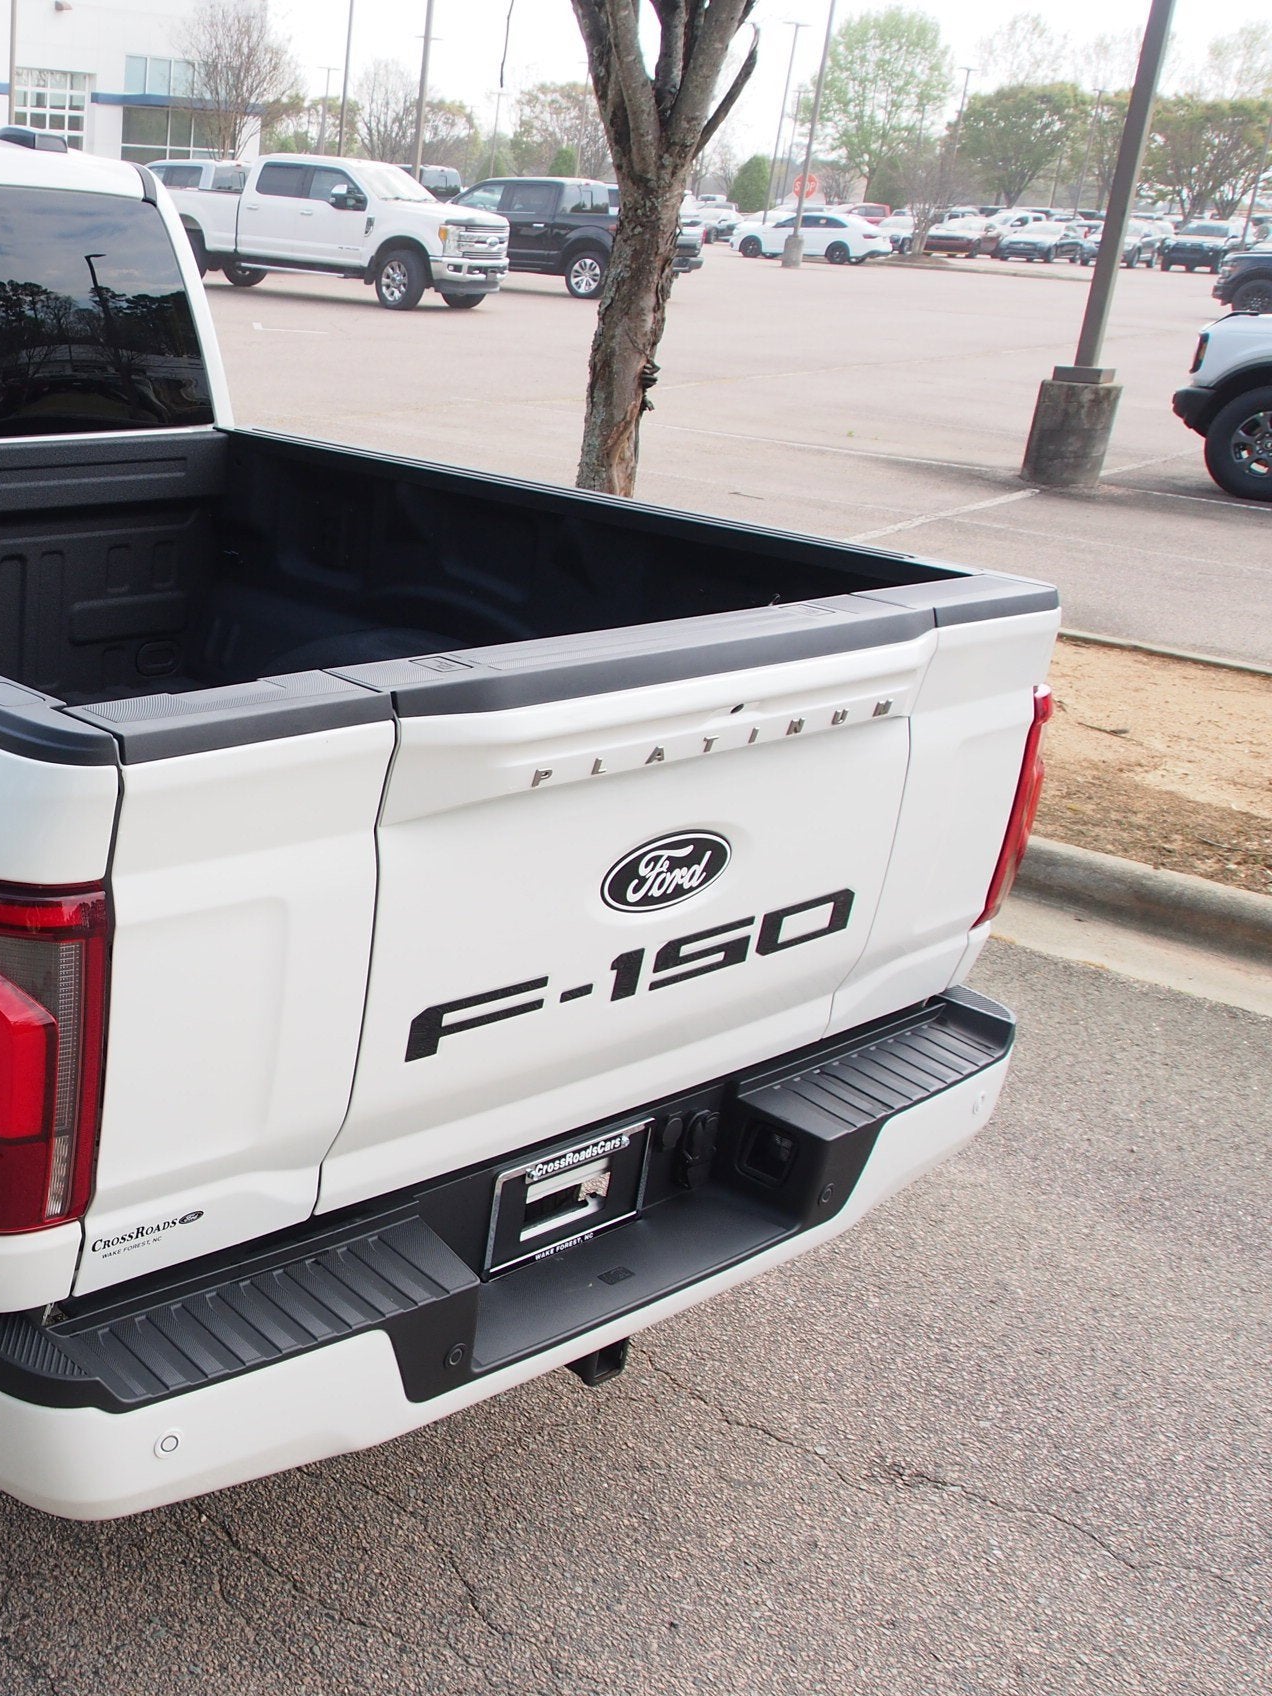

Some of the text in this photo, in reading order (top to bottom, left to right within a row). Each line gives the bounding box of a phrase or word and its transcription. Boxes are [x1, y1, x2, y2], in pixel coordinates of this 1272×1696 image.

[530, 697, 895, 788] PLATINUM
[625, 843, 712, 904] Ford
[404, 887, 856, 1063] F-150
[535, 1137, 621, 1177] CrossRoadsCars
[101, 1249, 122, 1259] WAKE
[152, 1236, 162, 1244] NC
[534, 1248, 555, 1260] WAKE
[584, 1232, 594, 1241] NC
